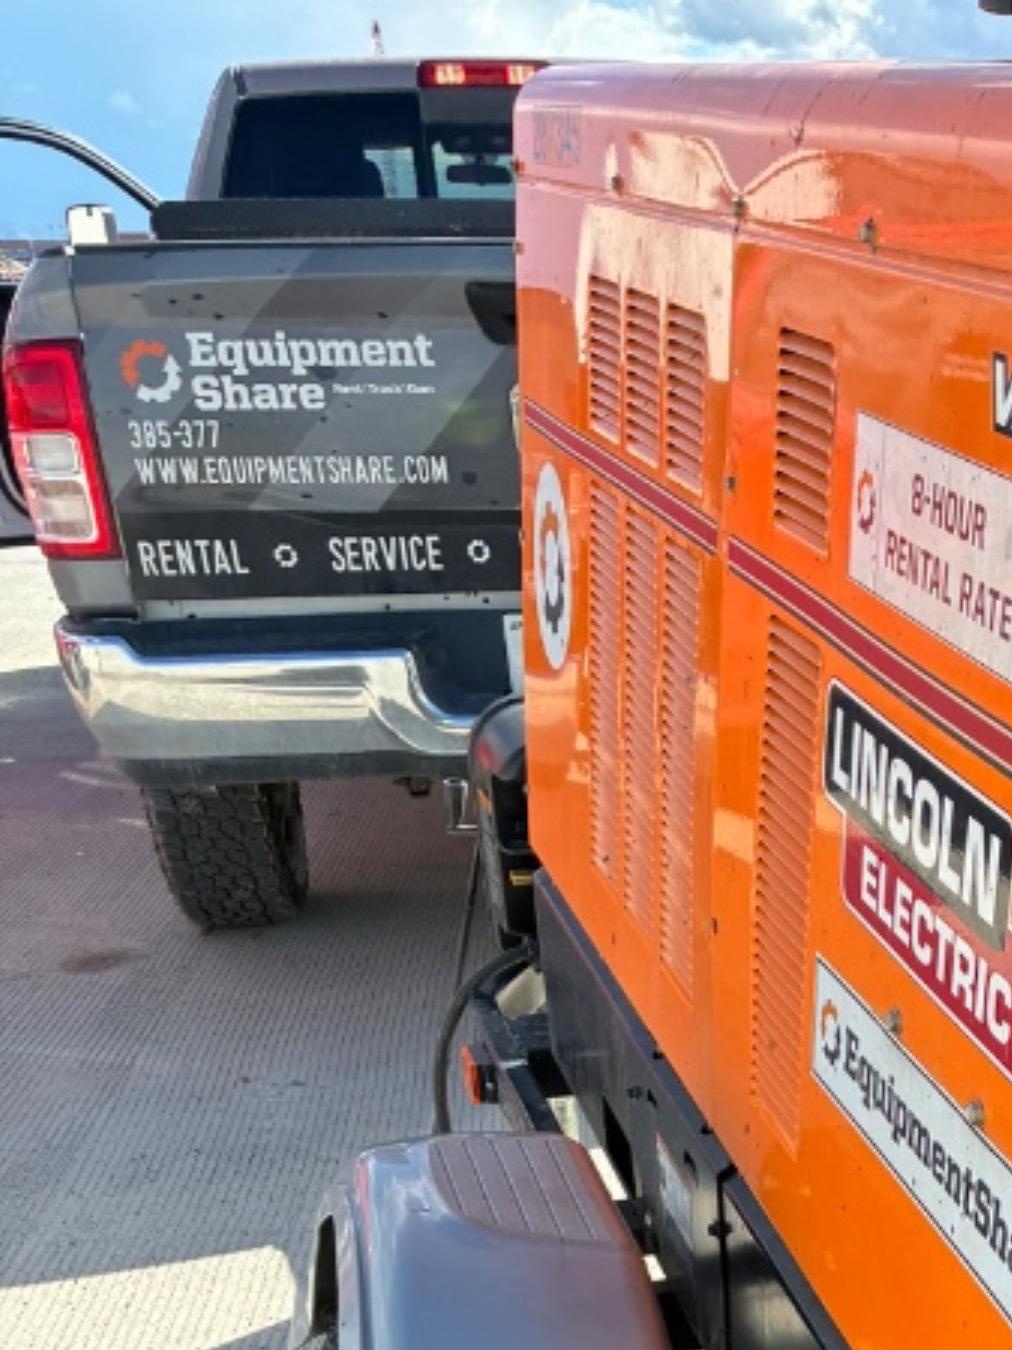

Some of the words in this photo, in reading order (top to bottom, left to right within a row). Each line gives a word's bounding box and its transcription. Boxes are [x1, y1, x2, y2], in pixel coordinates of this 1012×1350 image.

[185, 331, 435, 376] Equipment
[192, 376, 325, 412] Share
[129, 419, 220, 448] 385-377
[134, 456, 448, 485] WWW.EQUIPMENTSHARE.COM
[910, 473, 988, 549] 8-HOUR
[137, 539, 250, 577] RENTAL
[329, 536, 444, 573] SERVICE
[884, 535, 952, 605] RENTAL
[831, 707, 1000, 927] LINCOLN
